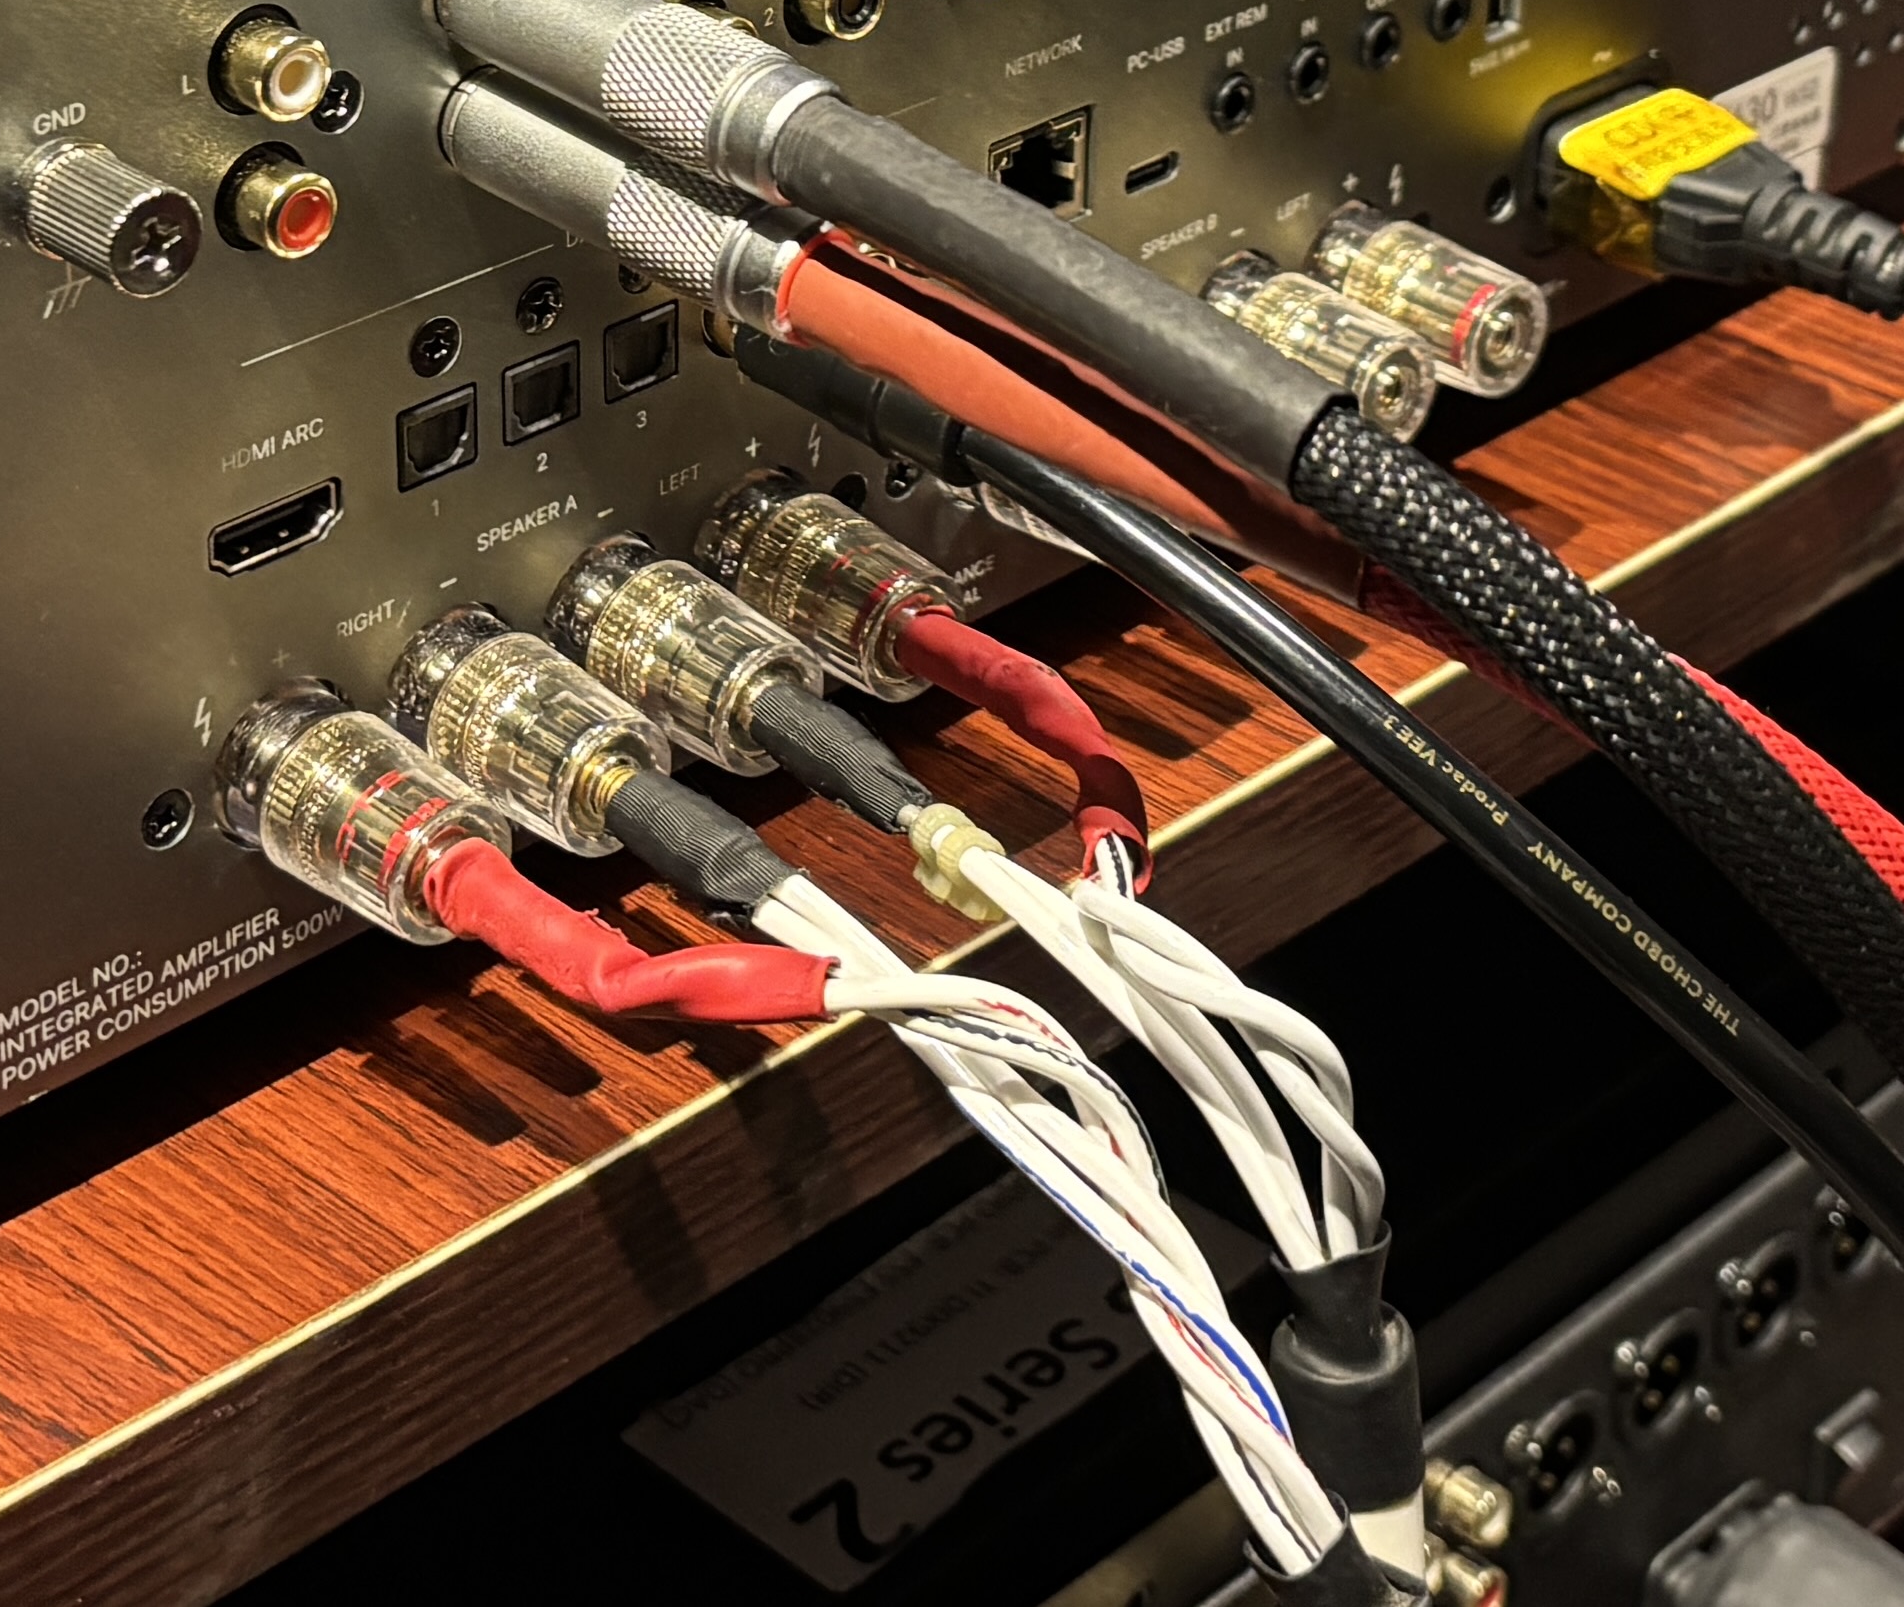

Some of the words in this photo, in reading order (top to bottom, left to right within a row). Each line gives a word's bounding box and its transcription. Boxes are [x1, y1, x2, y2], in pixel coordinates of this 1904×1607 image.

[763, 6, 775, 27] 2
[1205, 16, 1233, 42] EXT
[1235, 3, 1269, 30] REM
[1300, 16, 1319, 38] IN
[1005, 34, 1083, 79] NETWORK
[1127, 36, 1186, 74] PC-USB
[1226, 47, 1245, 68] IN
[181, 75, 195, 95] L
[32, 102, 86, 136] GND
[1141, 219, 1206, 261] SPEAKER
[635, 410, 648, 428] 3
[220, 432, 277, 472] HDMI
[281, 418, 325, 451] ARC
[536, 452, 549, 472] 2
[659, 463, 701, 496] LEFT
[430, 499, 441, 517] 1
[476, 506, 562, 553] SPEAKER
[562, 494, 578, 514] A
[336, 598, 397, 638] RIGHT
[1440, 760, 1511, 828] Prodac
[1526, 838, 1633, 934] COMPANY
[92, 950, 144, 989] NO.:
[1633, 929, 1704, 999] CHORD
[0, 970, 154, 1062] INTEGRATED
[159, 907, 282, 984] AMPLIFIER
[1, 1028, 92, 1091] POWER
[96, 934, 277, 1042] CONSUMPTION
[281, 901, 346, 950] 500W
[1701, 994, 1741, 1038] THE
[877, 1317, 1121, 1484] Series
[788, 1476, 923, 1566] 2
